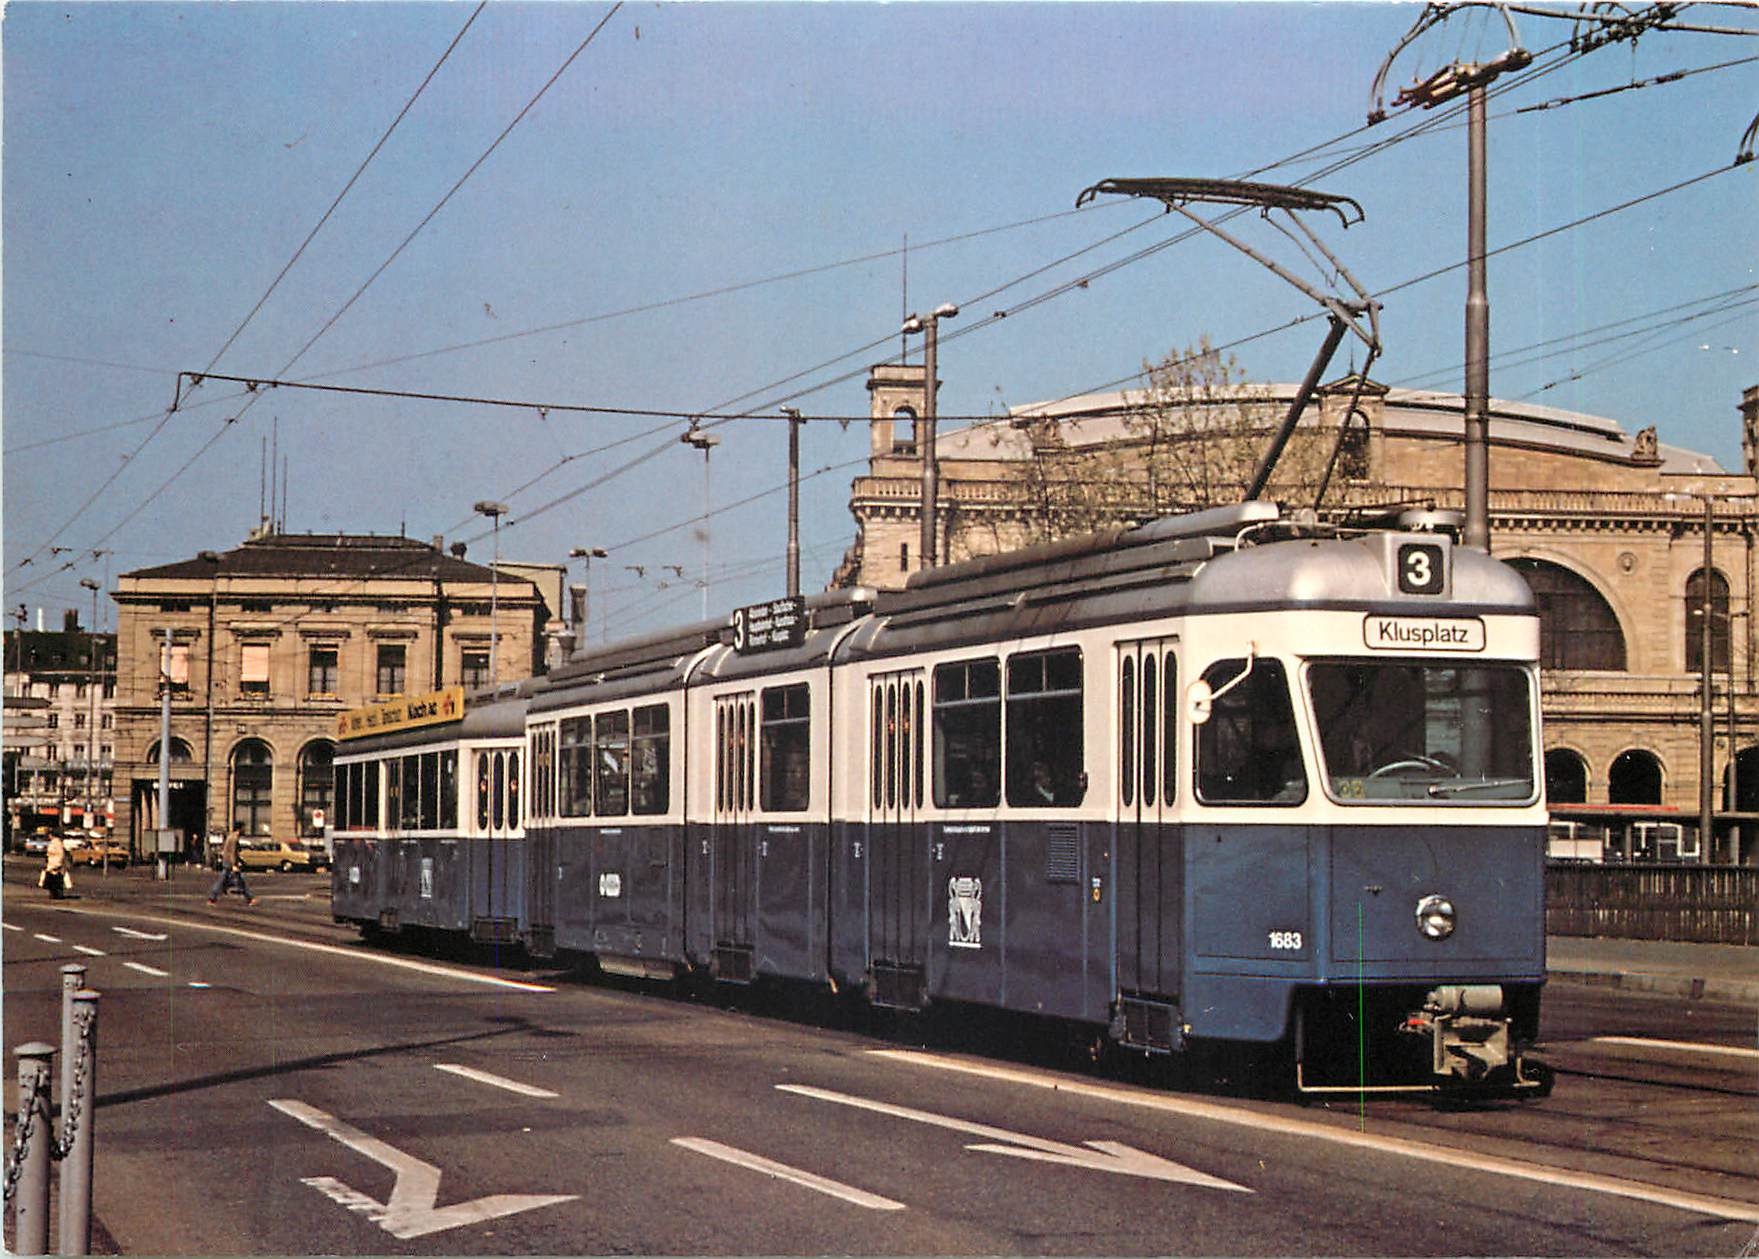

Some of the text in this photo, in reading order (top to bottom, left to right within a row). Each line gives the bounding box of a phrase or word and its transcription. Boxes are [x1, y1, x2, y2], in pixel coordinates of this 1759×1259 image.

[1407, 551, 1432, 587] 3
[734, 610, 744, 649] 3
[1379, 620, 1468, 646] Klusplatz
[1268, 931, 1302, 950] 1683
